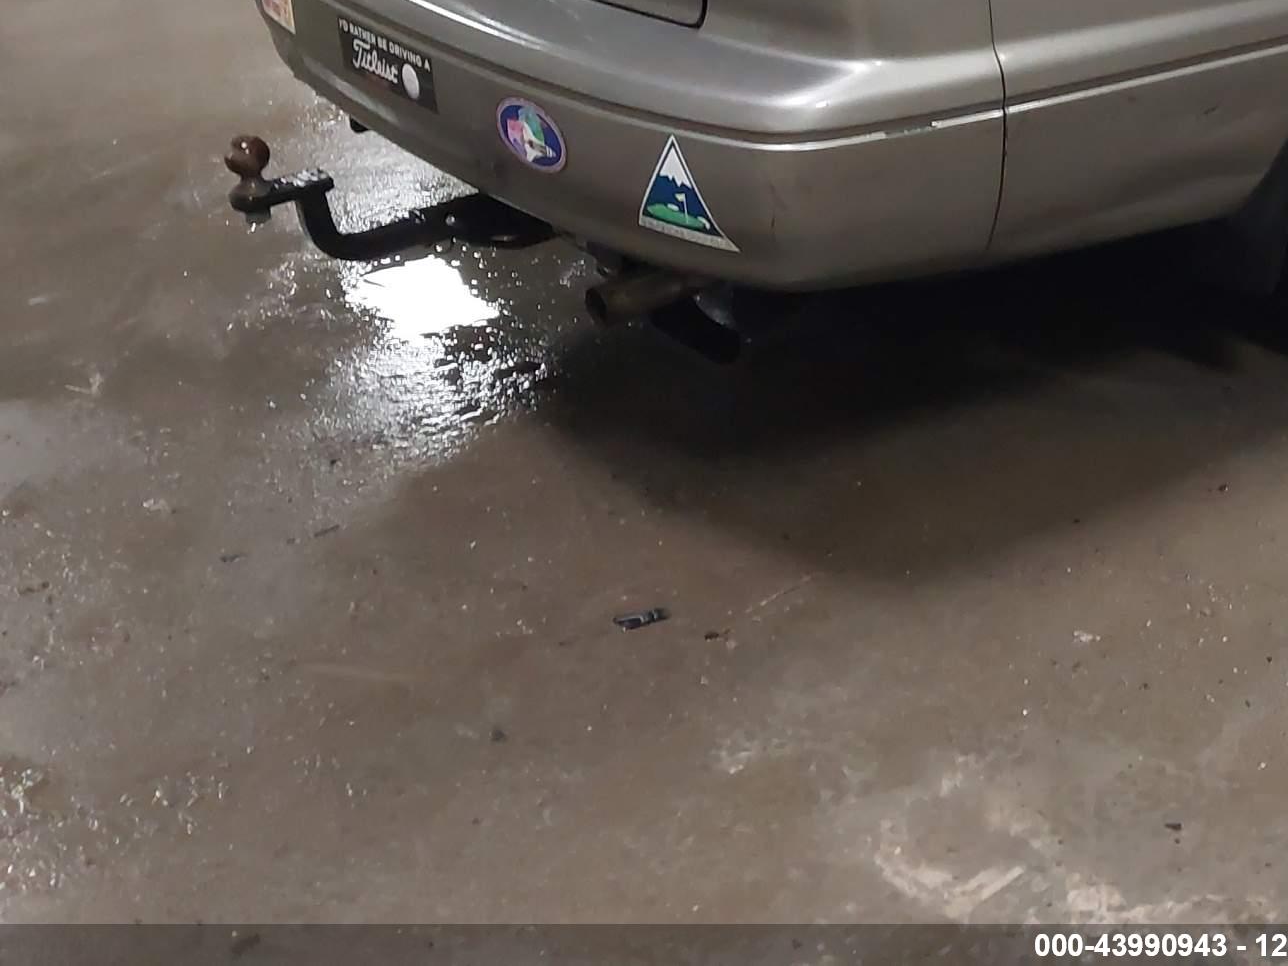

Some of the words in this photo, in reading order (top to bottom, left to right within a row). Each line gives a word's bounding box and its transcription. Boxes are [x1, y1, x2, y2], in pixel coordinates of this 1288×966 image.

[349, 23, 376, 46] RATHER
[377, 36, 388, 51] BE
[389, 41, 422, 68] DRIVING
[424, 58, 431, 72] A
[352, 38, 399, 84] Titleist
